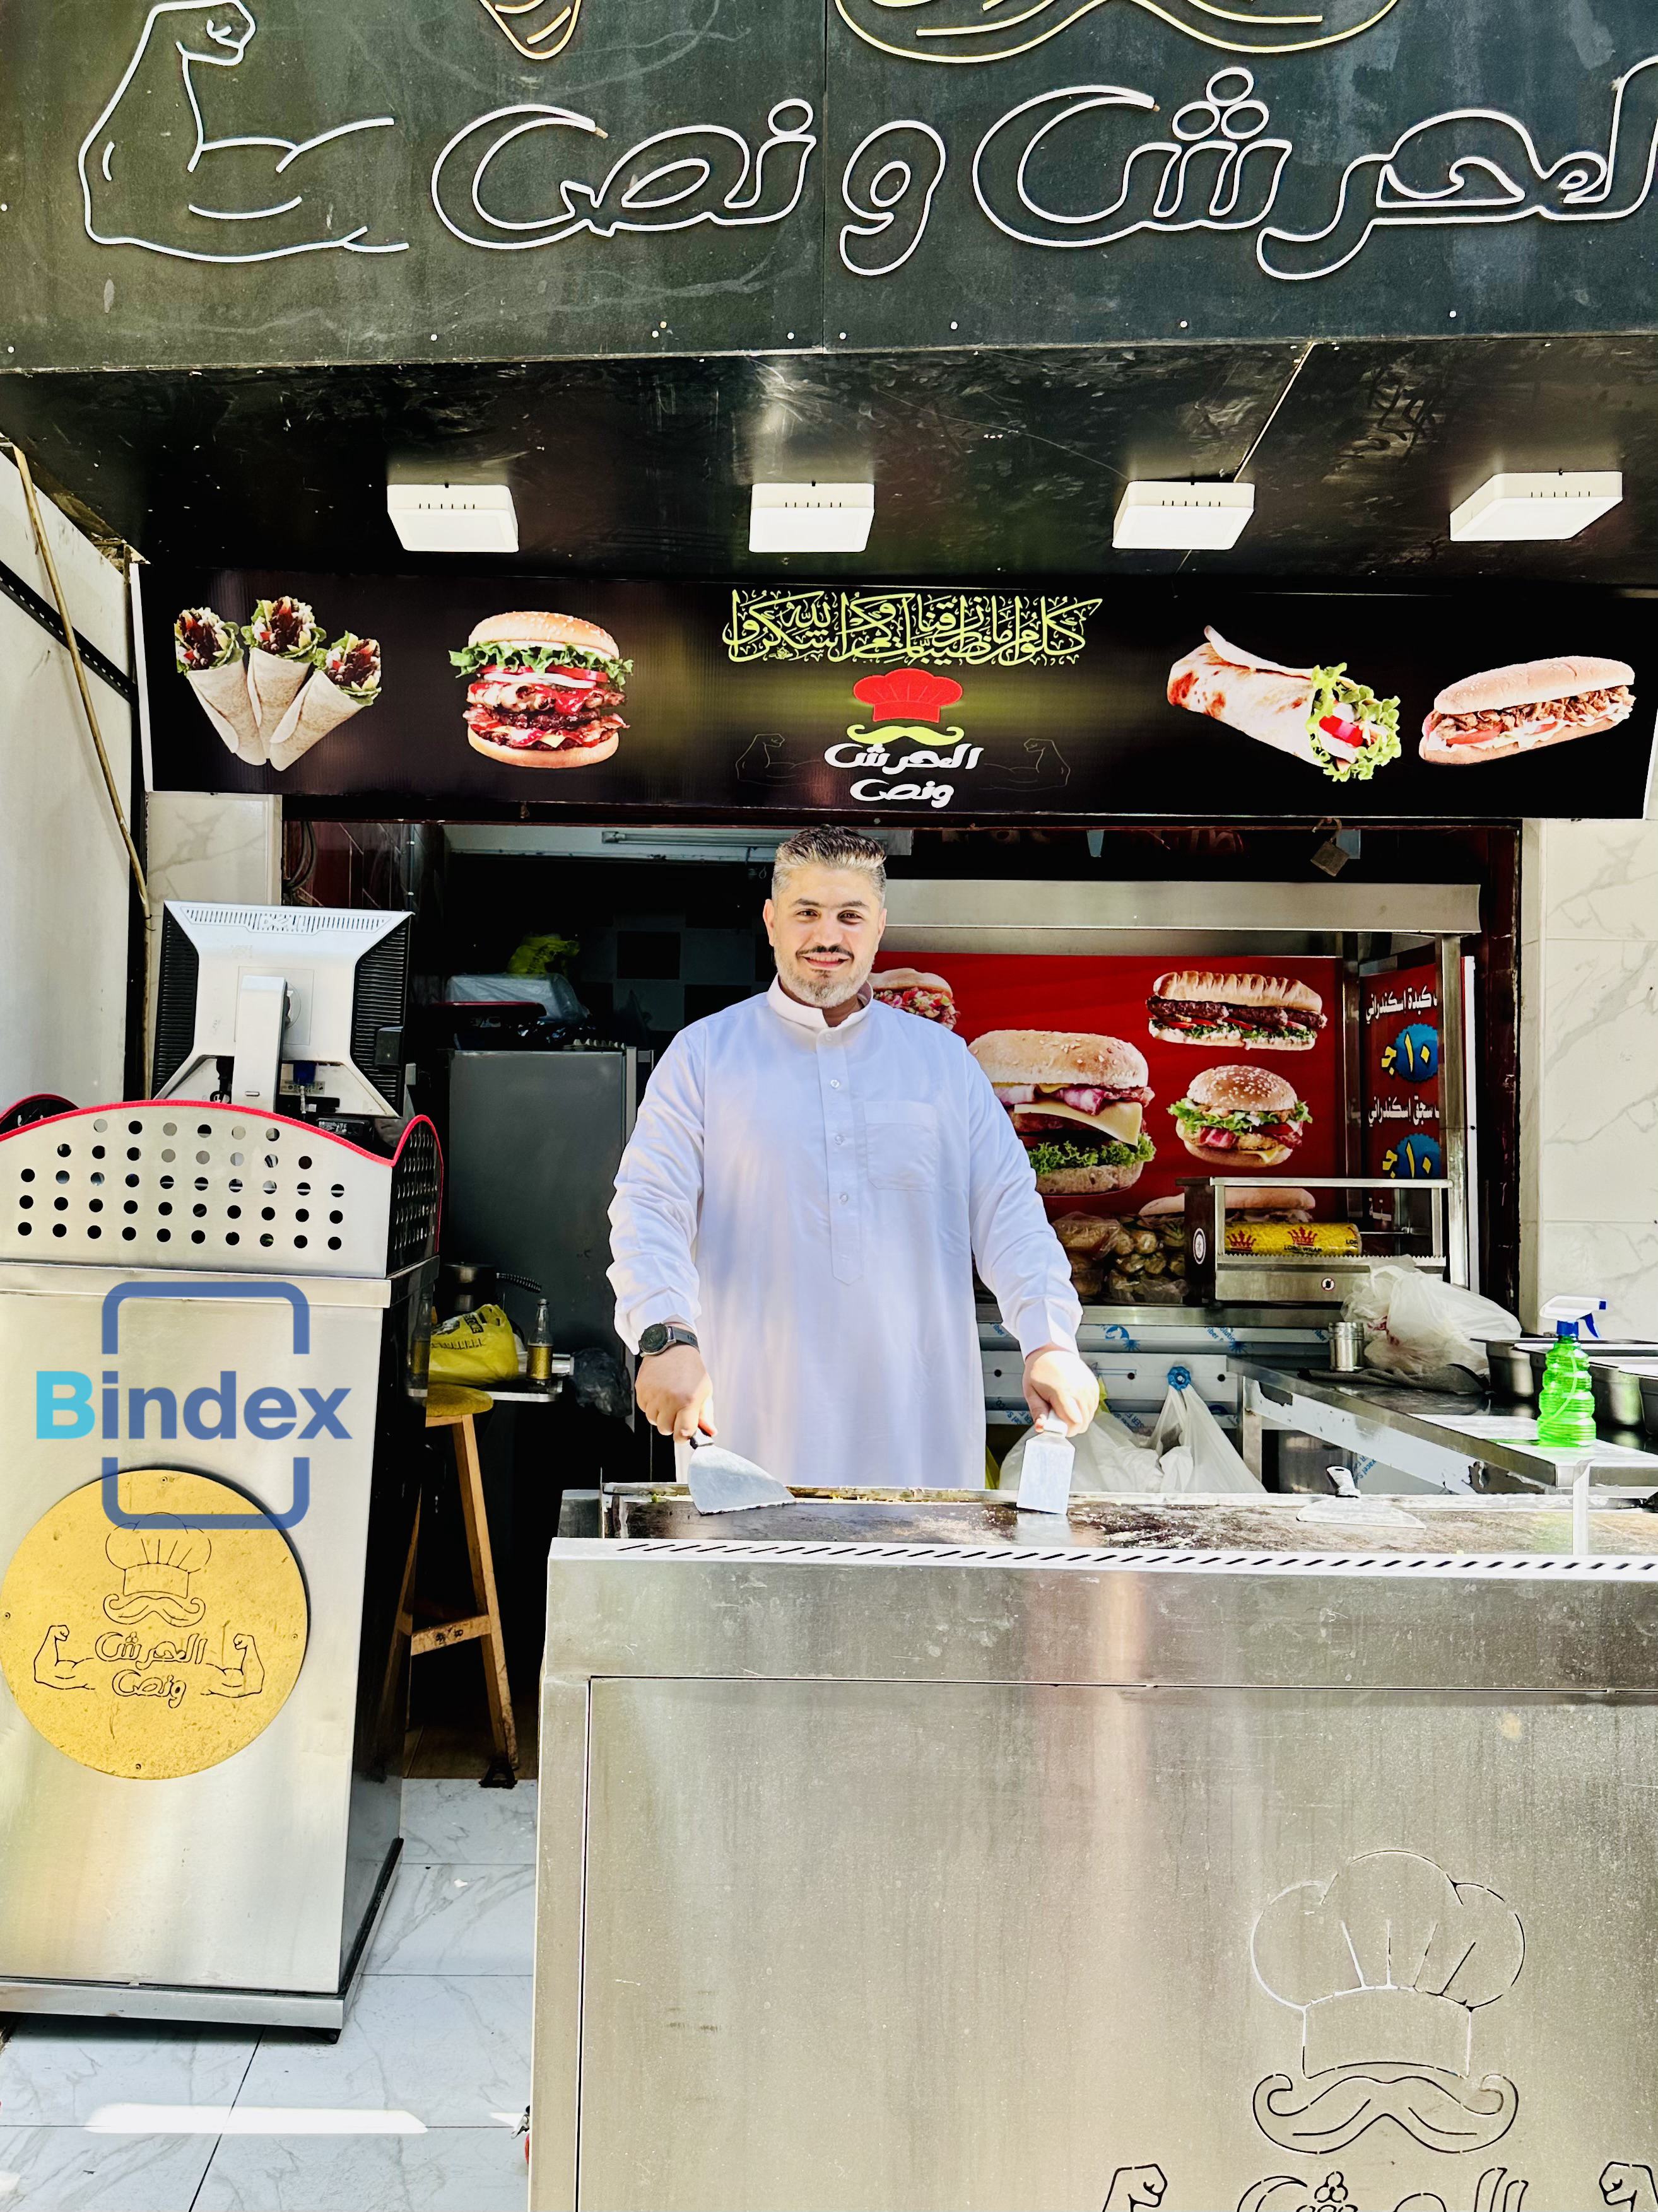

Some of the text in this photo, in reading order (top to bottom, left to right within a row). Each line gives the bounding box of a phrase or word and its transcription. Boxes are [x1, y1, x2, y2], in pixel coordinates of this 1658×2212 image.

[972, 54, 1658, 279] لمحرش
[850, 778, 955, 809] ونص
[1408, 985, 1432, 1015] كبدة
[1413, 1095, 1433, 1126] سجق
[112, 1669, 187, 1709] ونص
